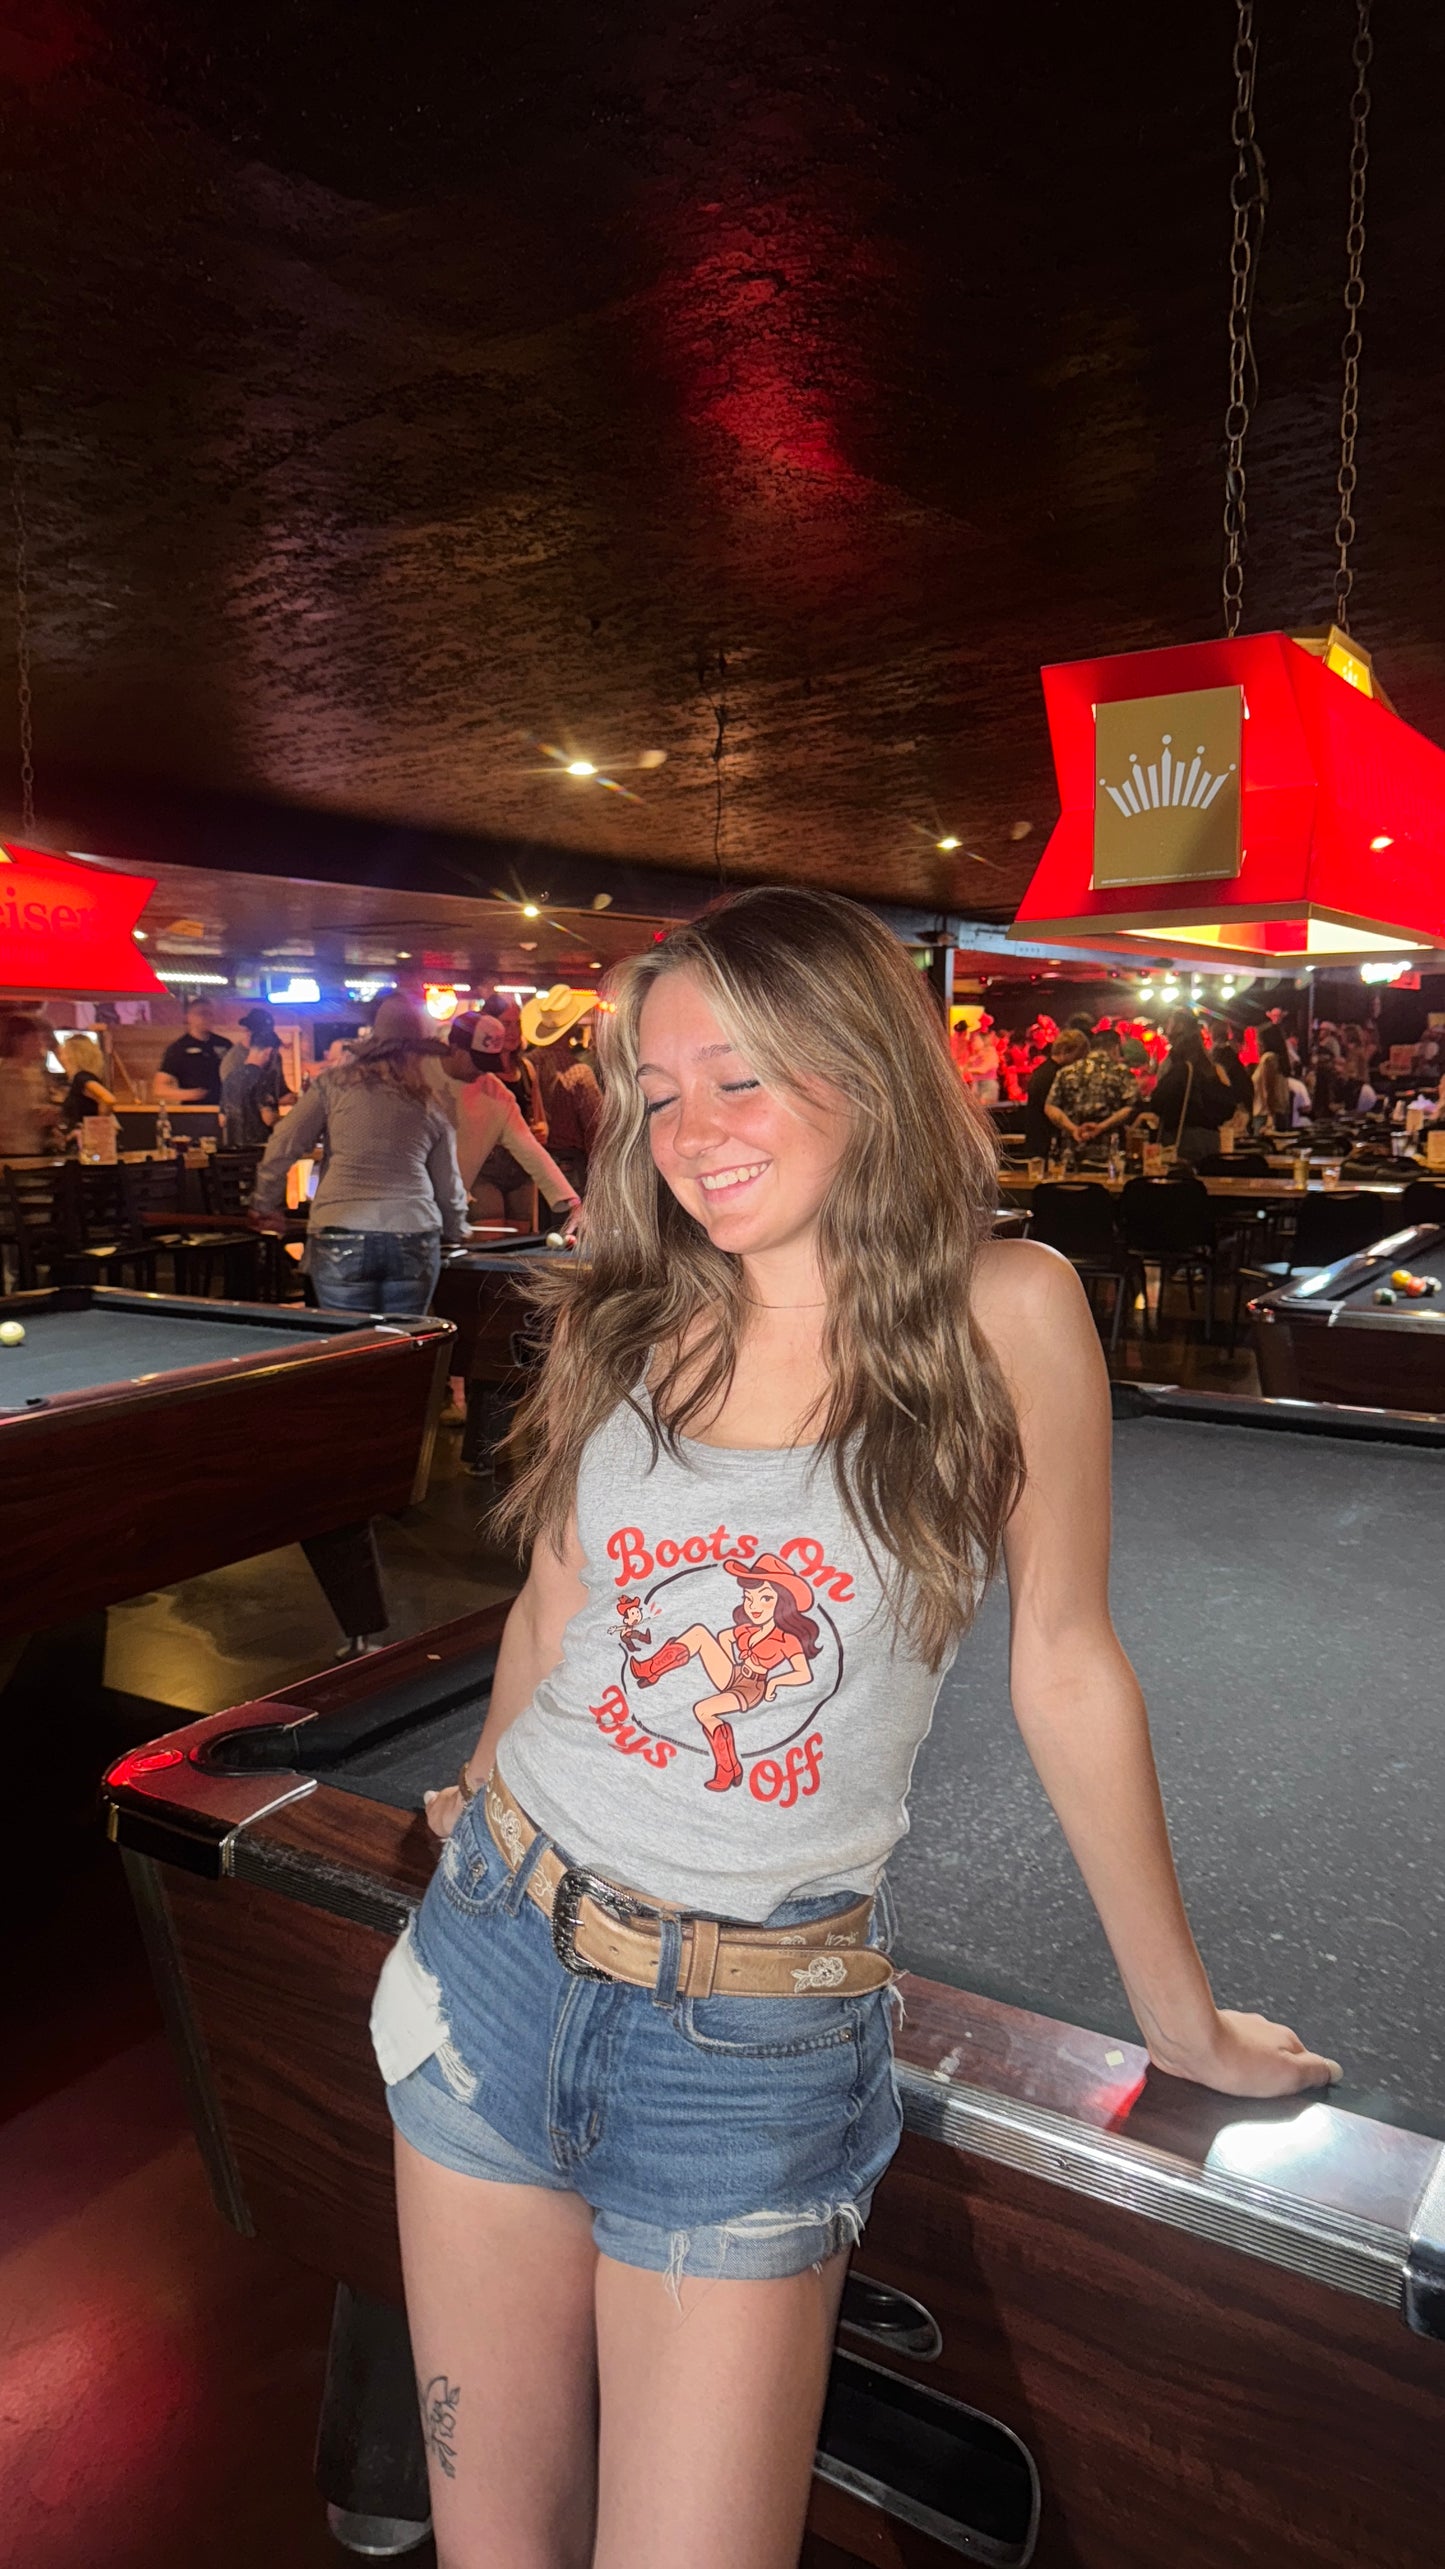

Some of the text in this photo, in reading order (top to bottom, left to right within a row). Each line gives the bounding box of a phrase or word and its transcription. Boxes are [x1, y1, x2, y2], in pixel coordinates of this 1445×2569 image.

[0, 885, 101, 939] iser
[606, 1525, 855, 1603] Boots On
[749, 1732, 824, 1809] Off
